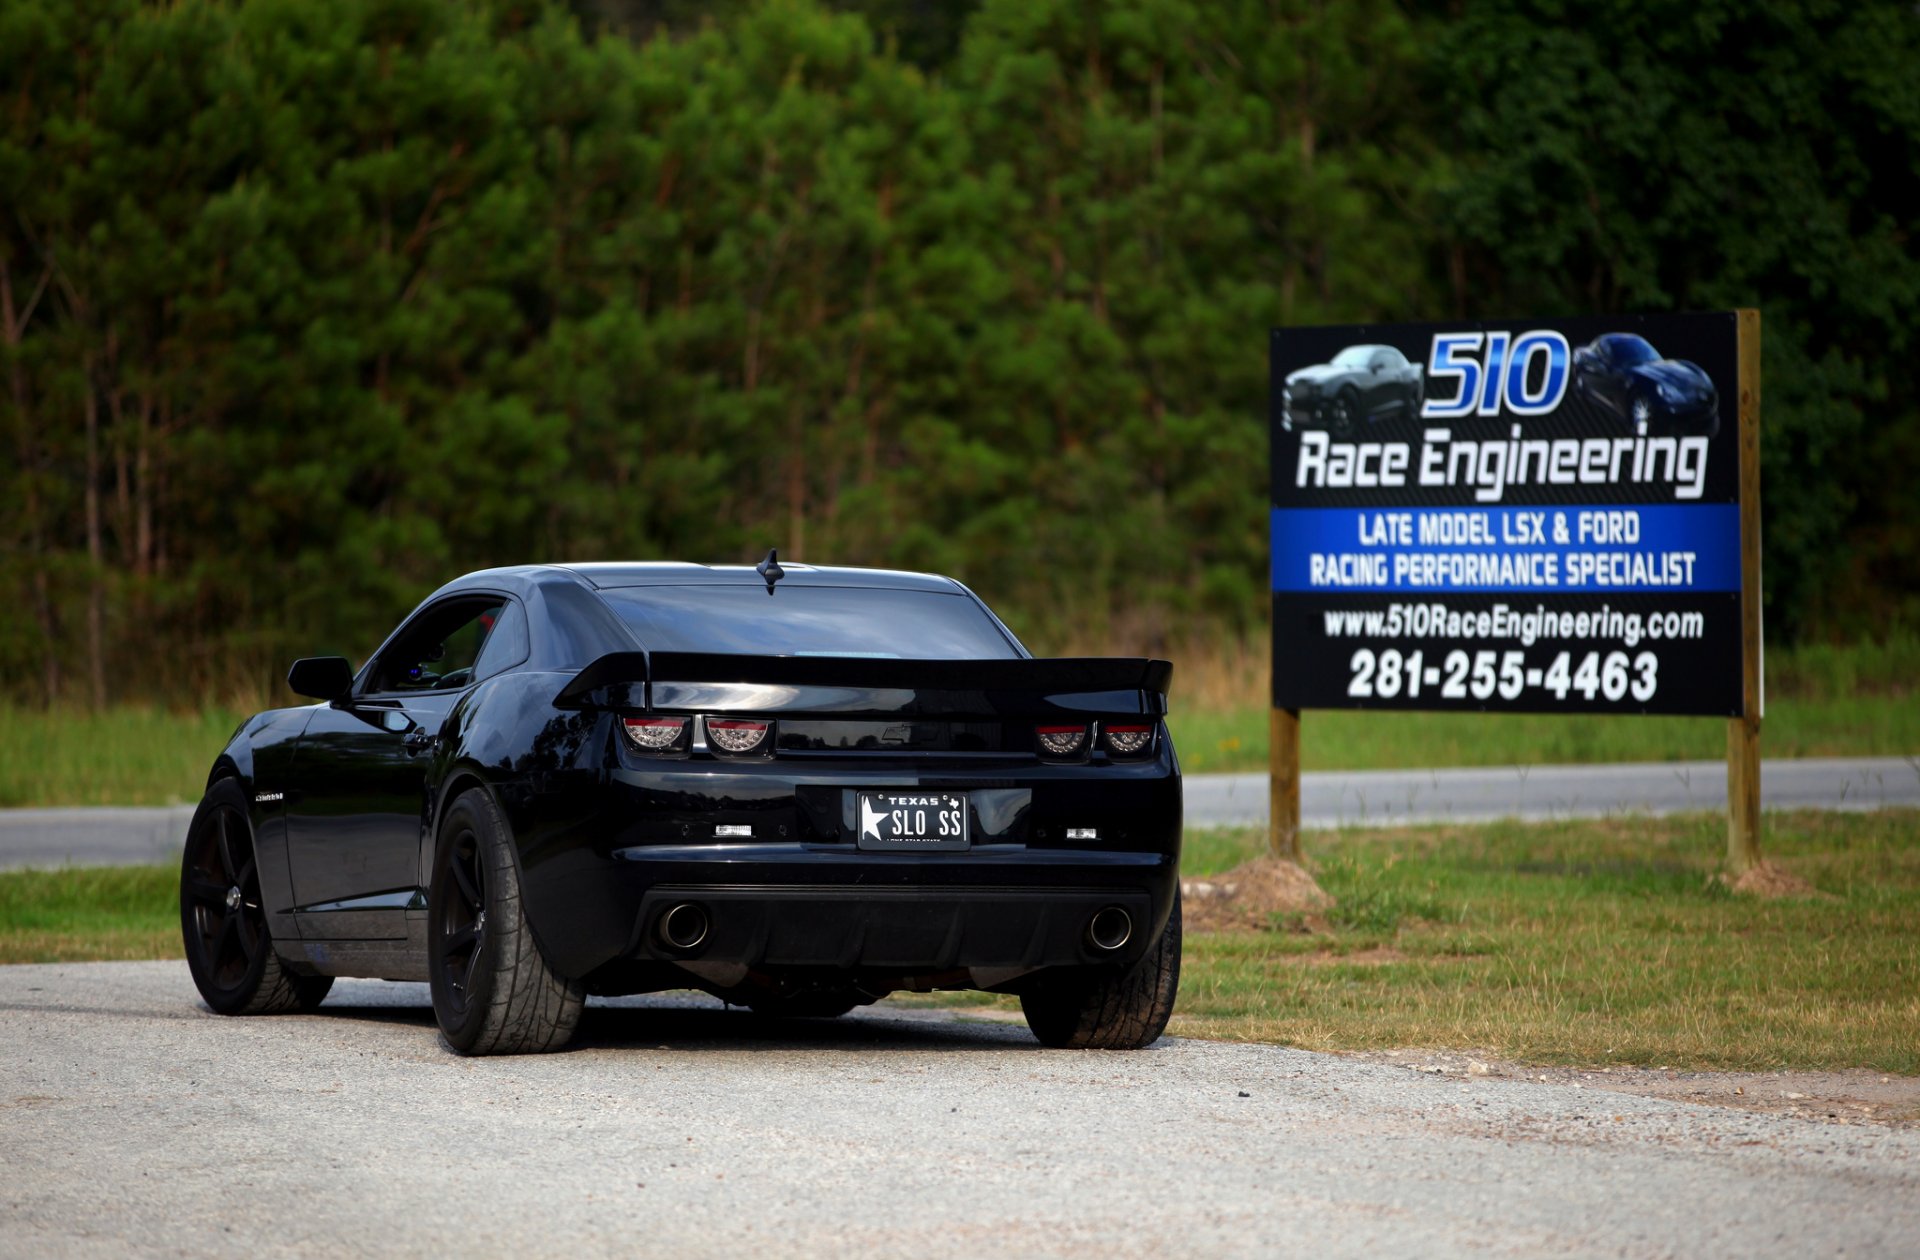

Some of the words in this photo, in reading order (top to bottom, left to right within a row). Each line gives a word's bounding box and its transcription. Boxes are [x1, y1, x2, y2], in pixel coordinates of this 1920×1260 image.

[1421, 330, 1571, 418] 510
[1297, 430, 1409, 487] Race
[1419, 423, 1709, 501] Engineering
[1359, 513, 1412, 545] LATE
[1419, 512, 1496, 544] MODEL
[1502, 512, 1546, 544] LSX
[1553, 512, 1570, 543] &
[1578, 511, 1640, 543] FORD
[1310, 553, 1388, 586] RACING
[1394, 553, 1558, 586] PERFORMANCE
[1565, 552, 1696, 585] SPECIALIST
[1324, 604, 1704, 646] www.510RaceEngineering.com
[1347, 648, 1659, 700] 281-255-4463
[888, 797, 939, 806] TEXAS
[892, 810, 926, 835] SLO
[939, 810, 961, 836] SS
